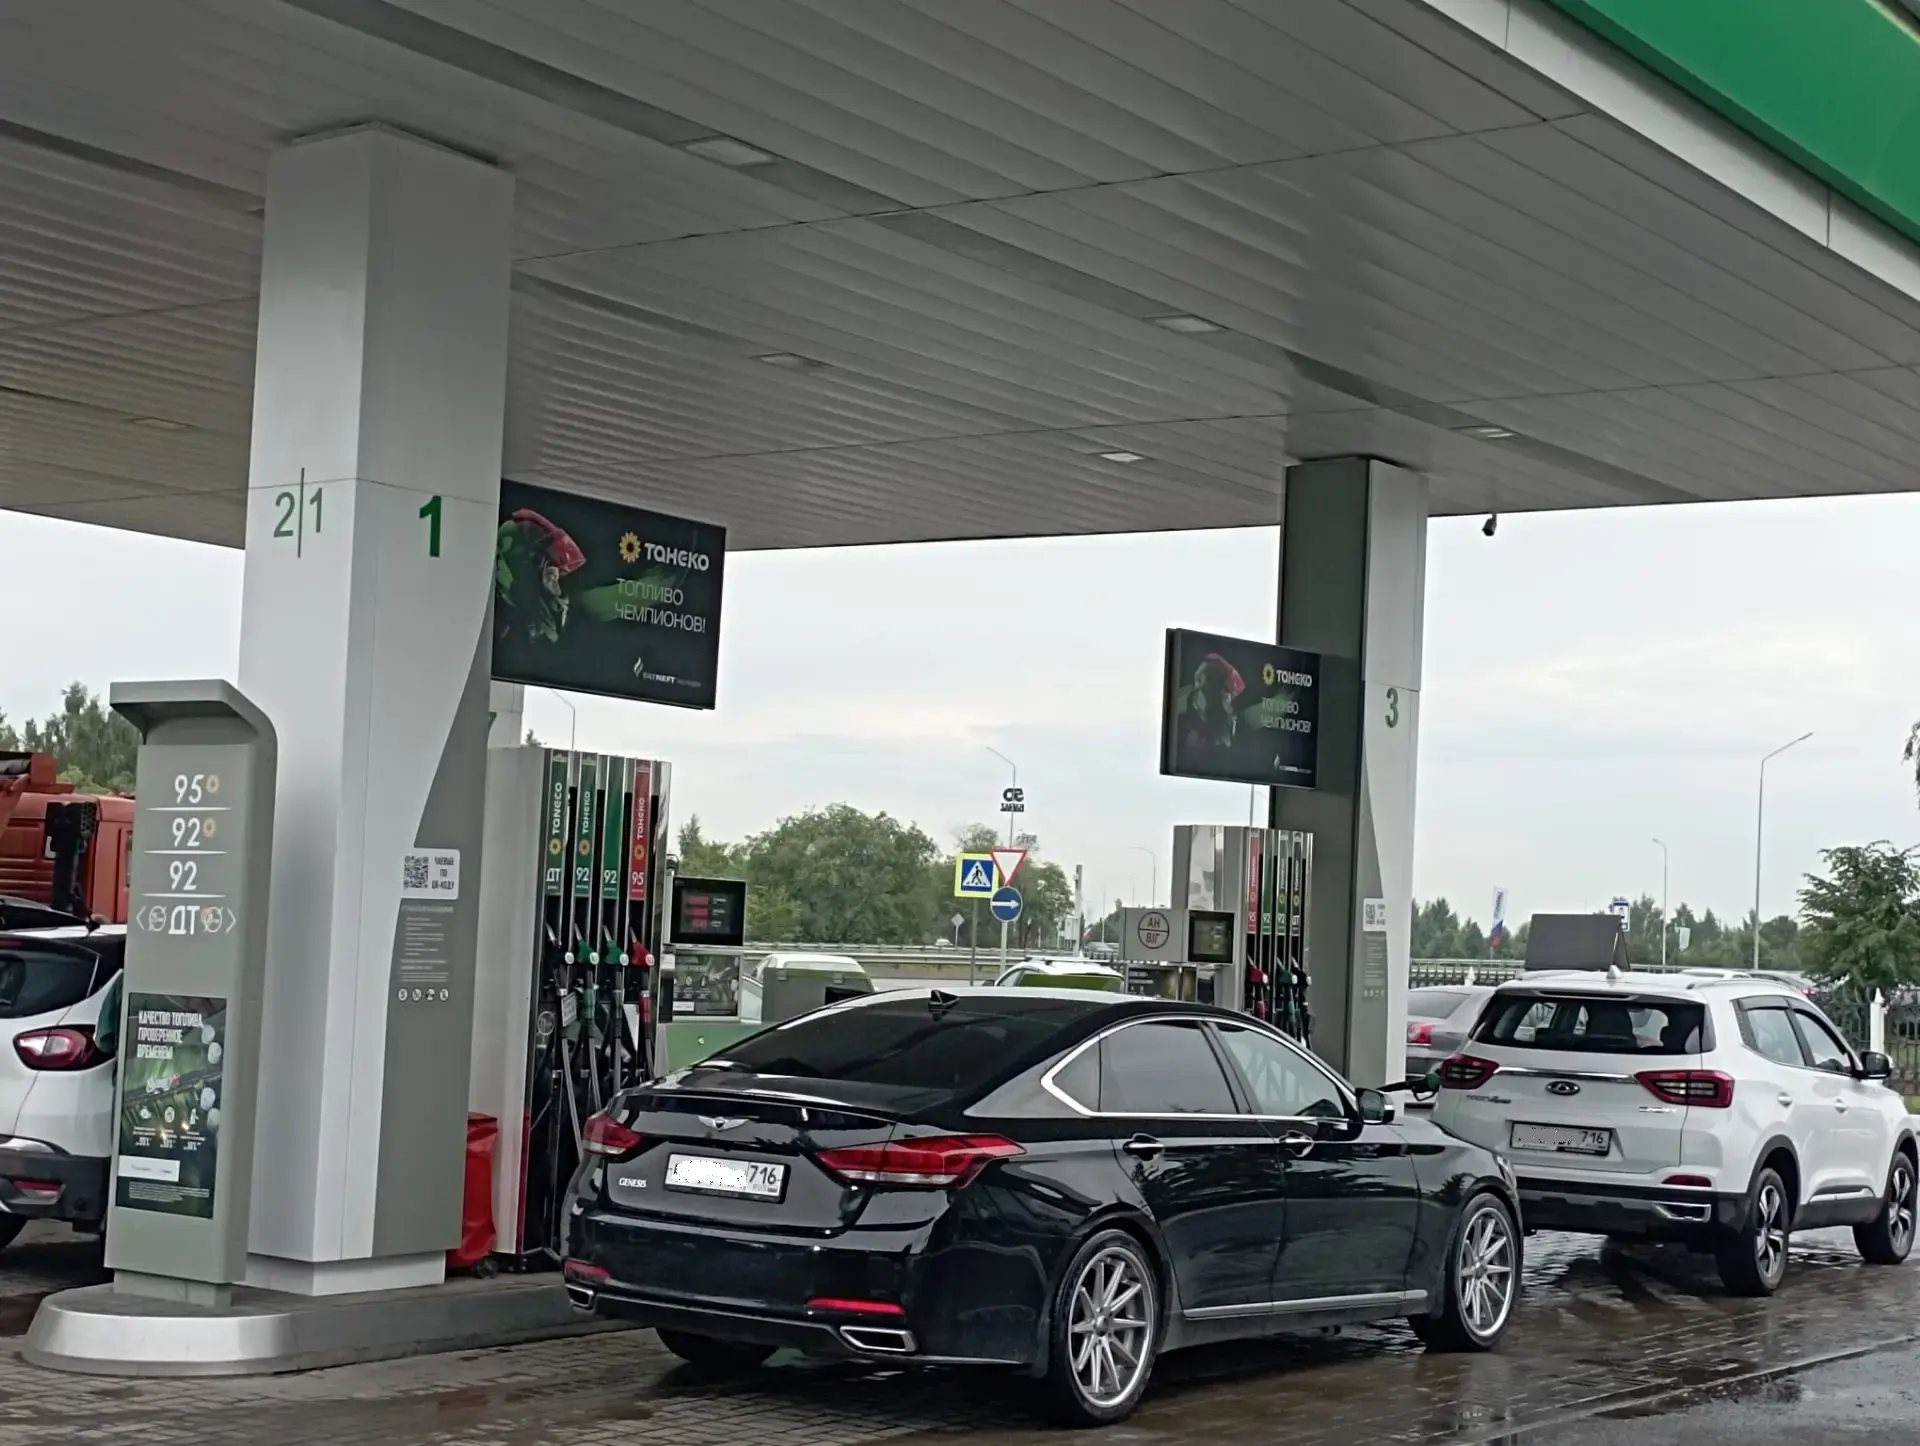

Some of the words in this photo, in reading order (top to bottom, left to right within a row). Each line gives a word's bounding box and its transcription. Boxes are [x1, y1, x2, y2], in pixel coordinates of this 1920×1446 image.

[419, 495, 442, 558] 1
[615, 578, 684, 606] ТОПЛИВО
[615, 602, 706, 633] ЧЕМПИОНОВ!
[1385, 687, 1399, 729] 3
[174, 774, 205, 804] 95
[172, 818, 201, 847] 92
[169, 861, 198, 890] 92
[546, 867, 561, 882] ДТ
[576, 867, 590, 882] 92
[603, 869, 617, 884] 92
[632, 872, 645, 886] 95
[168, 905, 201, 935] ДТ
[1262, 912, 1271, 924] 92
[1277, 912, 1285, 924] 92
[138, 1010, 171, 1025] КАЧЕСТВО
[1579, 1131, 1604, 1144] 716
[618, 1177, 647, 1188] GENESIS
[749, 1165, 778, 1185] 716
